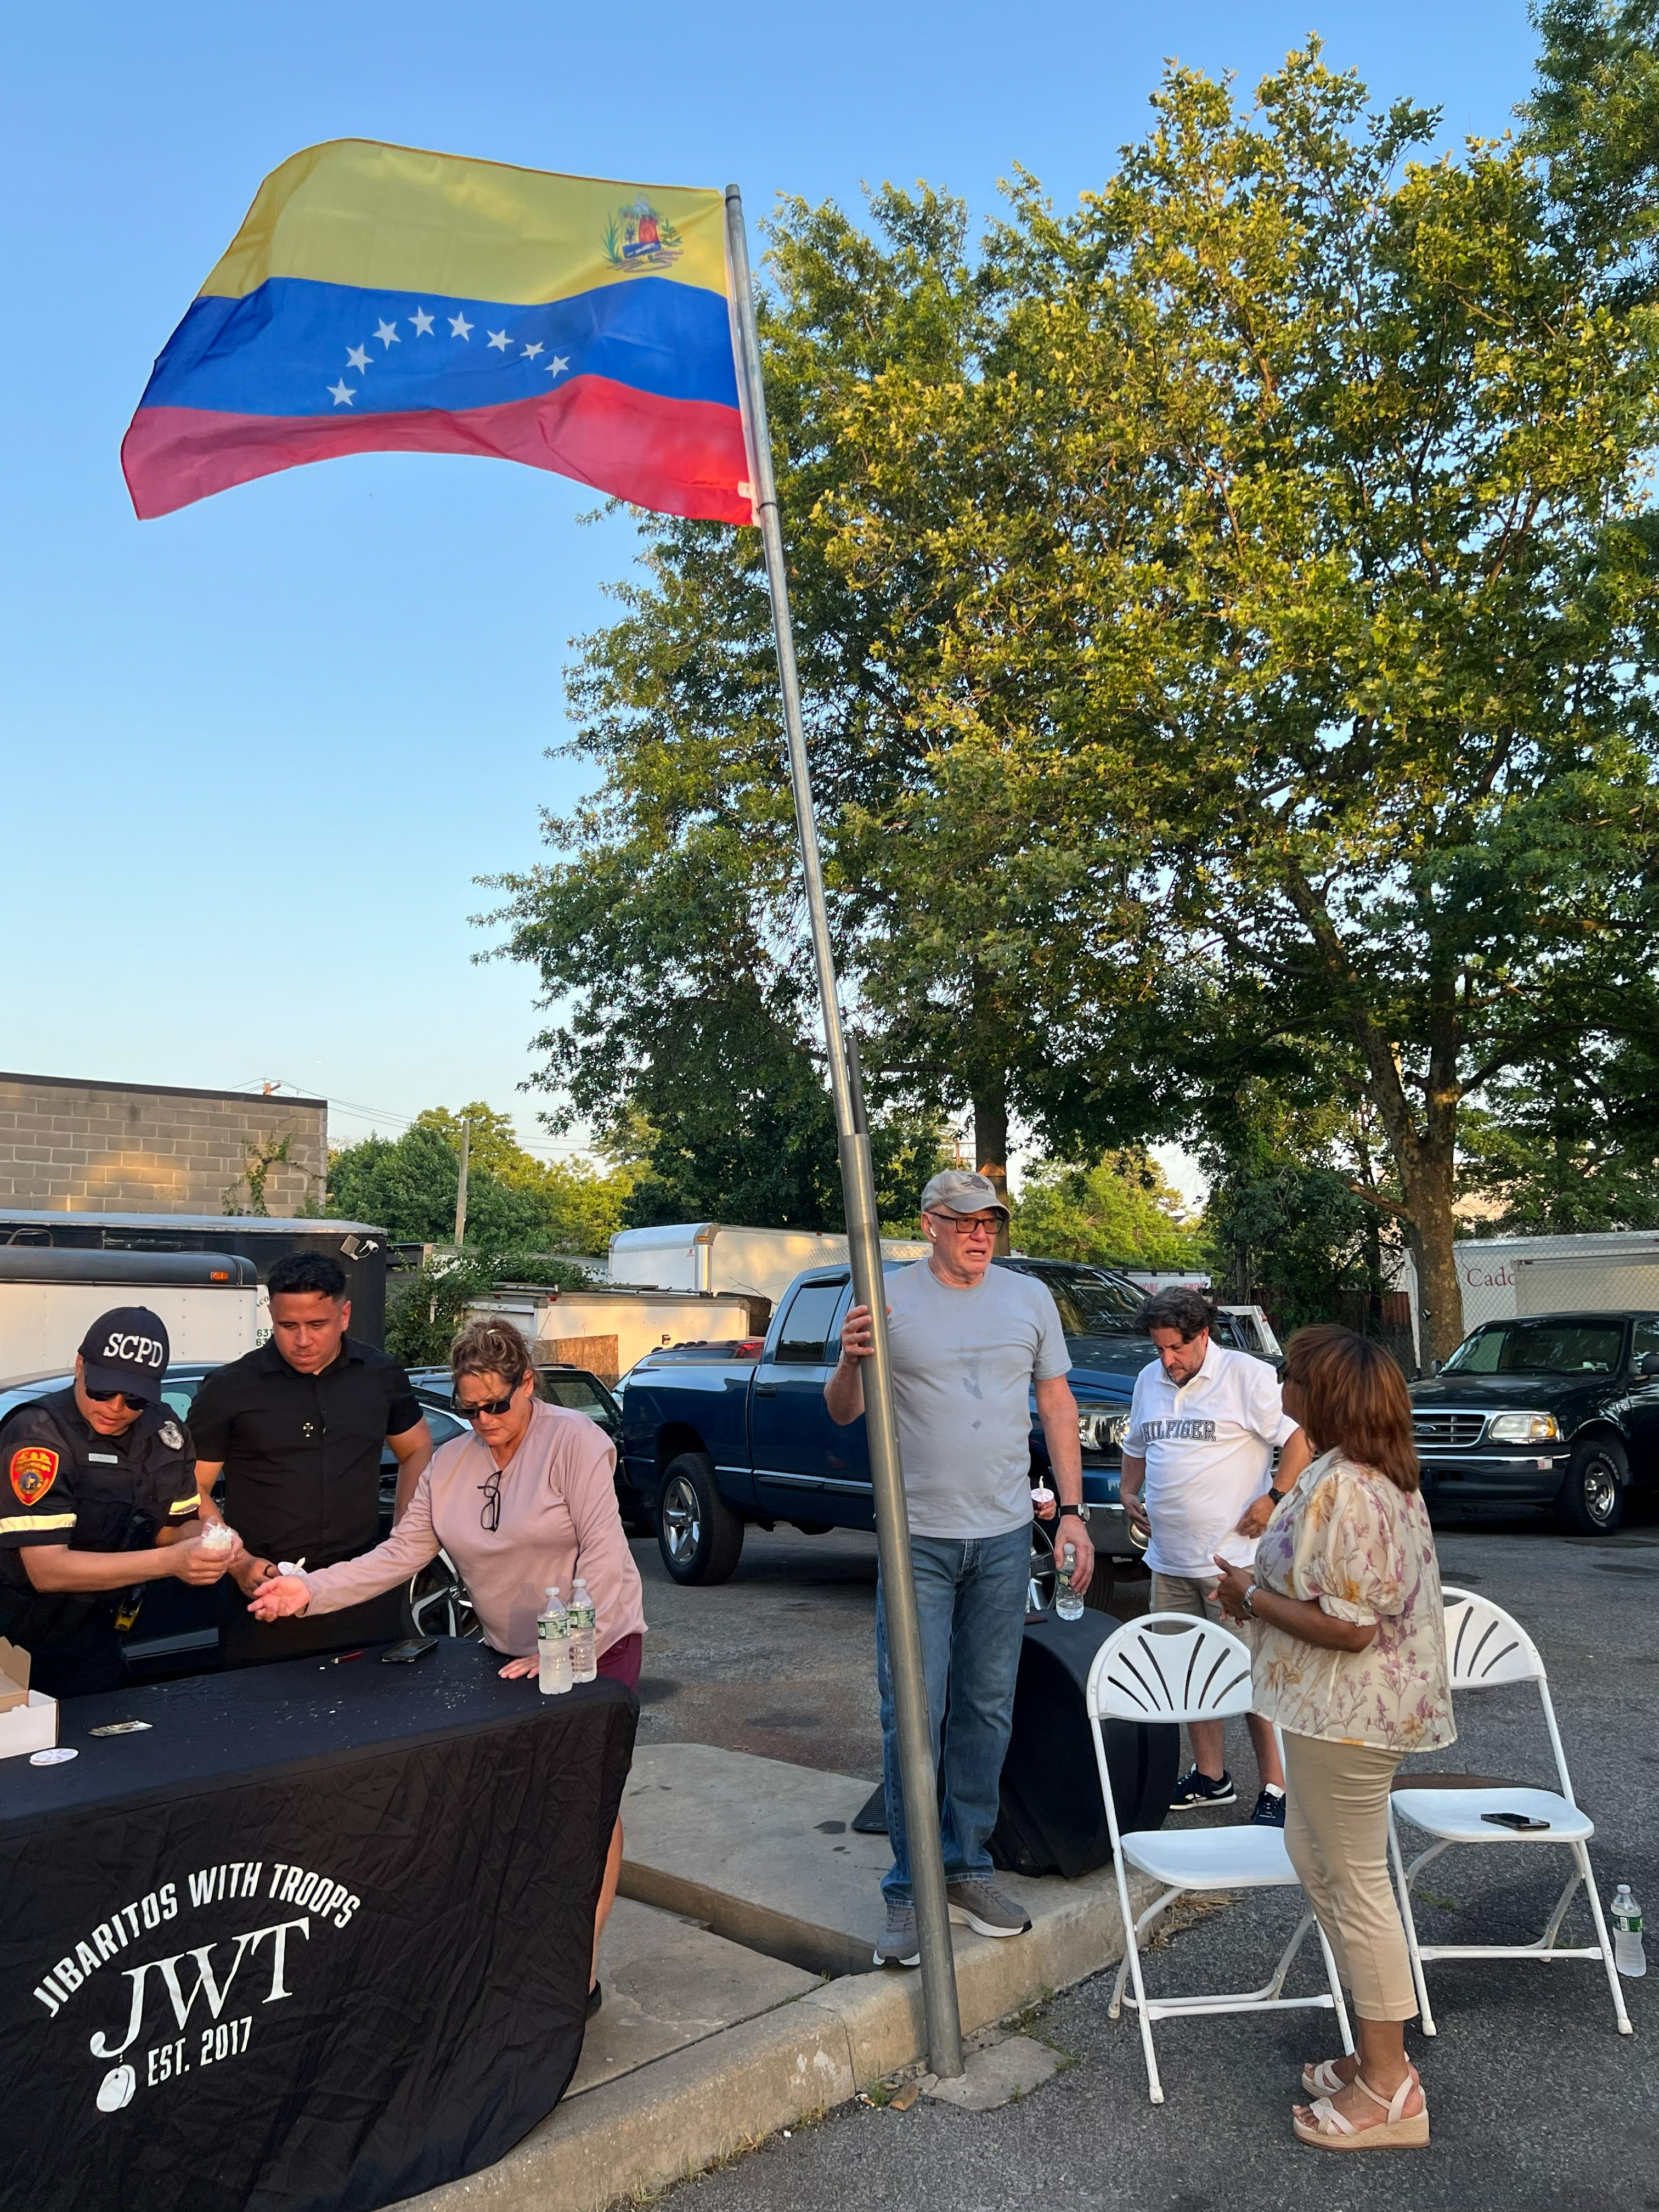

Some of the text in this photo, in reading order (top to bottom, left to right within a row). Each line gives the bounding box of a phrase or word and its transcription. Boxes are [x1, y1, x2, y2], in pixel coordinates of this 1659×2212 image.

[103, 1333, 163, 1368] SCPD
[1141, 1419, 1216, 1443] HILFIGER
[33, 1862, 361, 2018] JIBARITOS WITH TROOPS
[89, 1917, 309, 2058] JWT
[147, 2016, 253, 2087] EST. 2017
